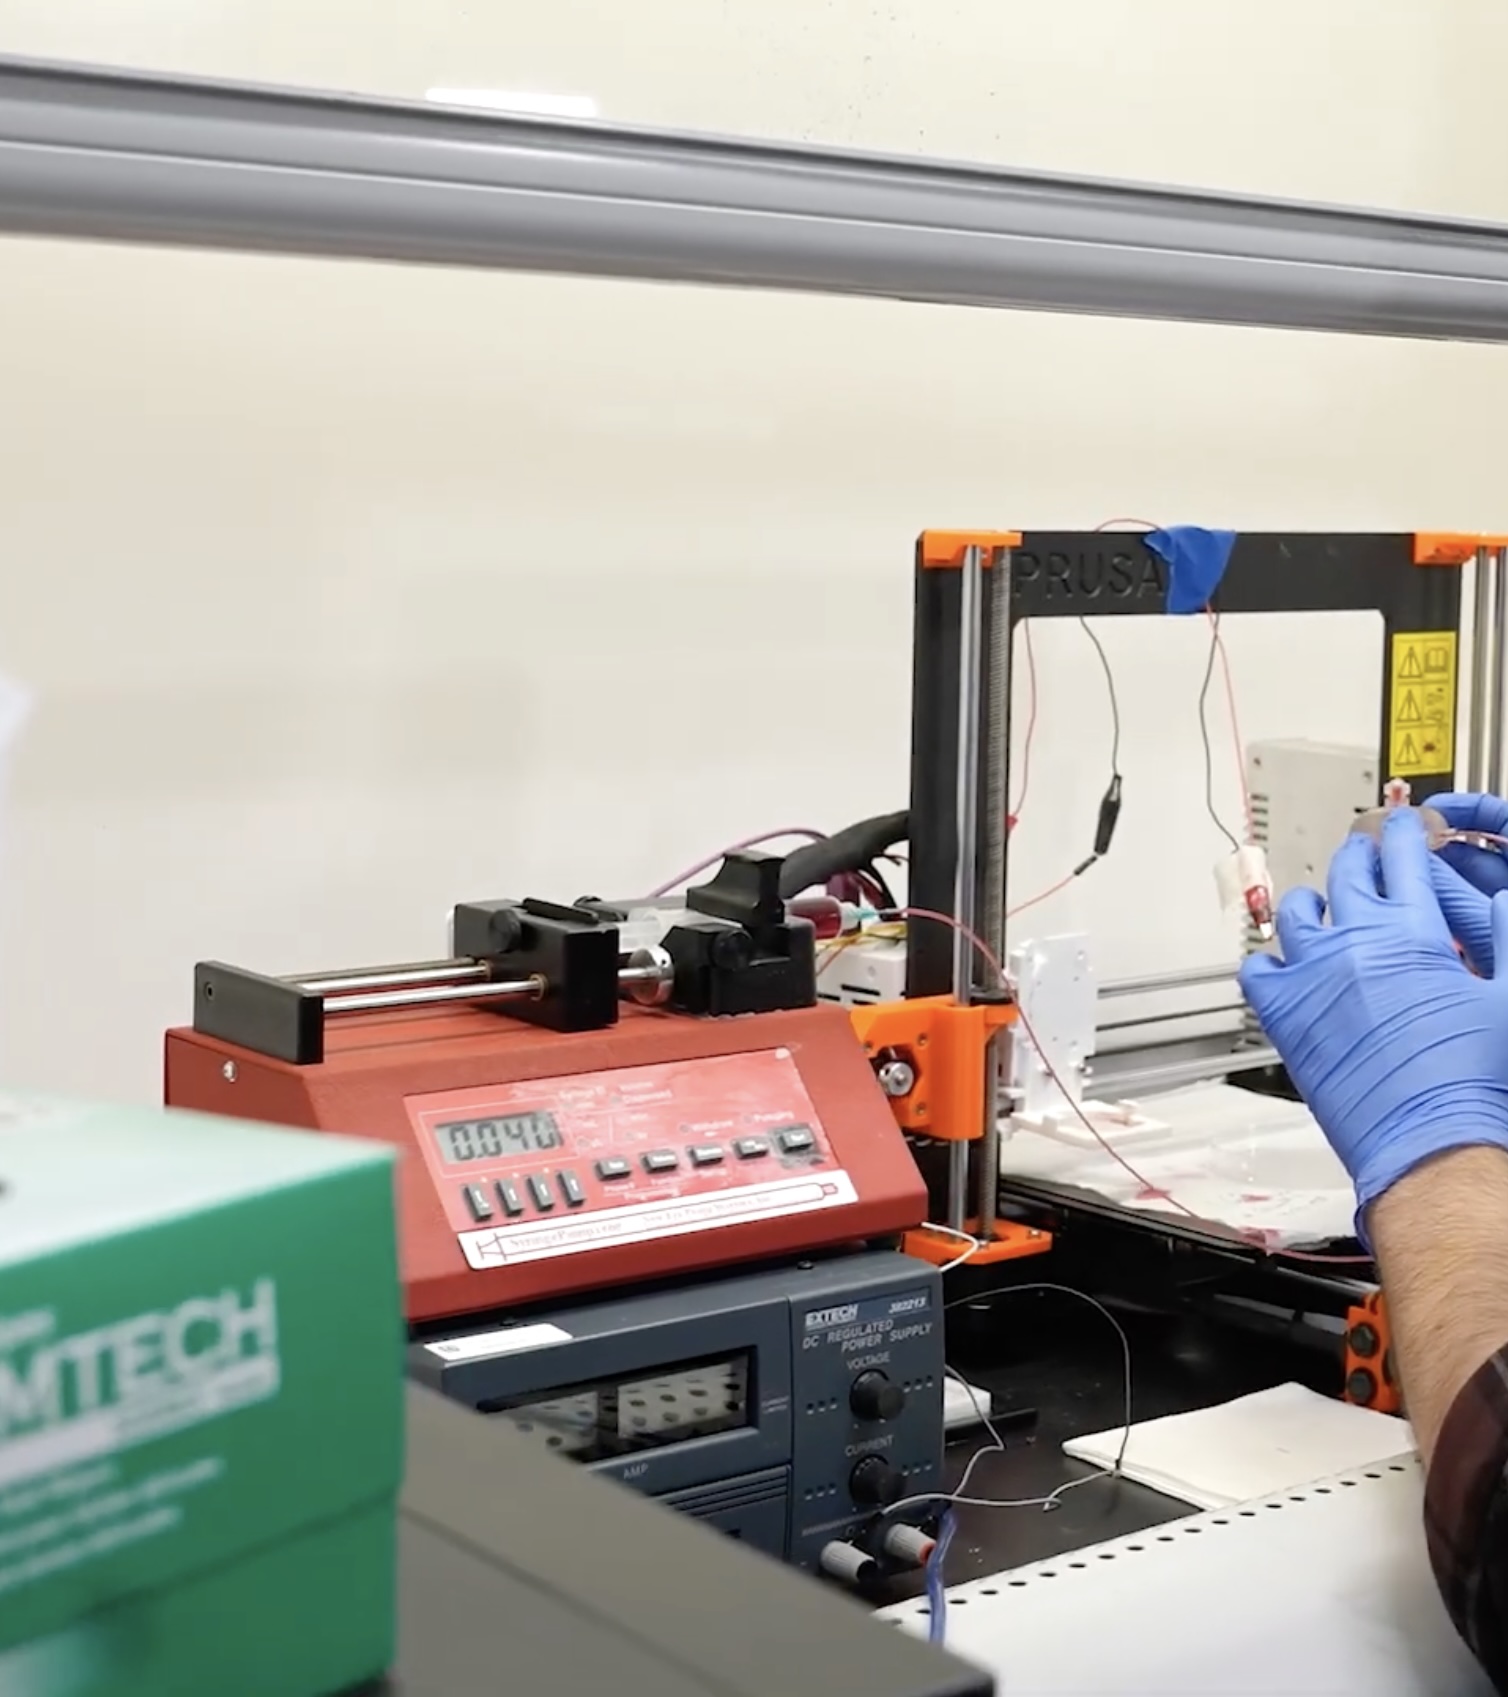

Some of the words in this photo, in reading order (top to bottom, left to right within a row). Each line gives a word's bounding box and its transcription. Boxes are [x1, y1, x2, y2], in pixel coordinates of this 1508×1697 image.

[1014, 552, 1165, 599] PRUSA
[805, 1303, 859, 1327] EXTECH
[802, 1335, 820, 1349] DC
[827, 1319, 894, 1344] REGULATED
[841, 1334, 883, 1352] POWER
[889, 1322, 933, 1342] SUPPLY
[846, 1351, 891, 1370] VOLTAGE
[845, 1435, 894, 1457] CURRENT
[623, 1462, 649, 1480] AMP
